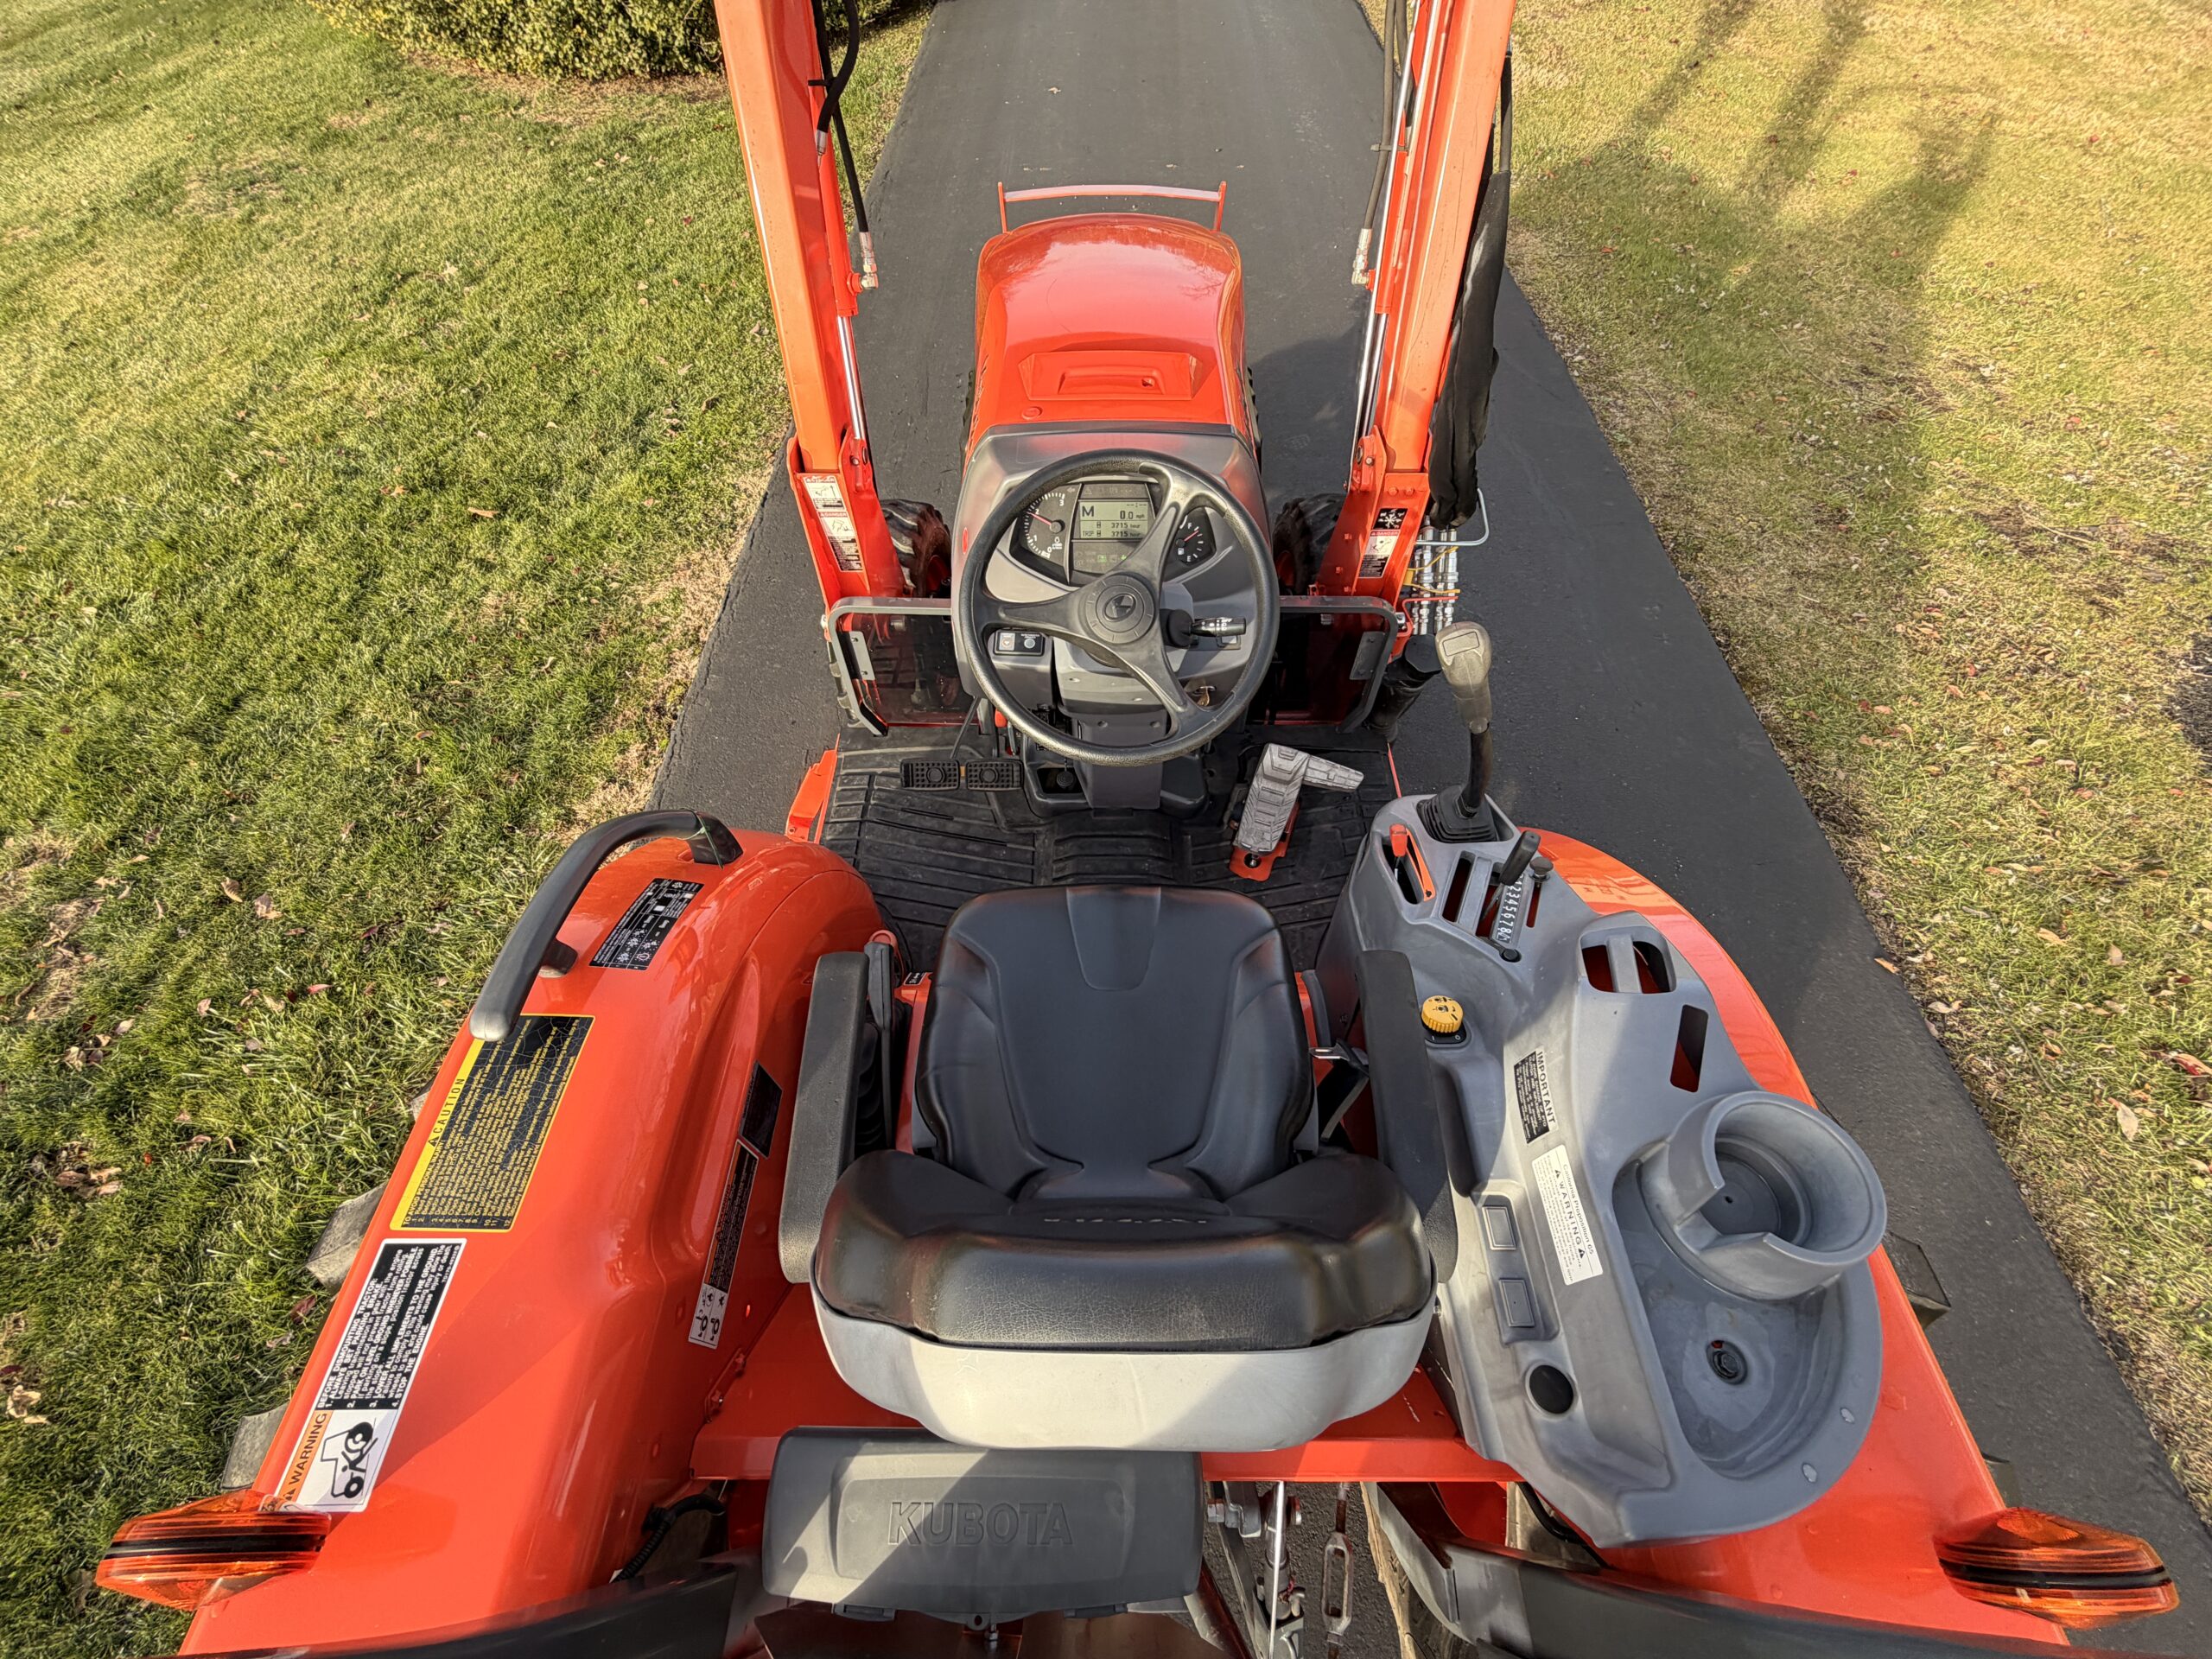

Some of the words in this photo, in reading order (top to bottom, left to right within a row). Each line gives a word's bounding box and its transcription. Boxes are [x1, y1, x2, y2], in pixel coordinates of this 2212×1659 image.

[1082, 505, 1094, 517] M
[432, 1077, 465, 1133] CAUTION
[1536, 1051, 1555, 1125] IMPORTANT
[416, 1162, 435, 1194] PERSONAL
[403, 1216, 411, 1224] TO
[406, 1196, 420, 1215] AVOID
[1558, 1180, 1581, 1245] WARNING
[409, 1294, 420, 1304] TO
[414, 1279, 426, 1293] THE
[316, 1376, 336, 1408] BEFORE
[332, 1318, 360, 1371] DISMOUNTING
[356, 1278, 378, 1314] TRACTOR:
[334, 1370, 353, 1398] Leaving
[347, 1325, 371, 1368] transmission
[371, 1300, 383, 1314] gear
[377, 1284, 388, 1298] with
[383, 1272, 393, 1282] the
[389, 1249, 404, 1270] engine
[342, 1370, 360, 1398] stopped
[355, 1356, 365, 1368] will
[360, 1343, 371, 1354] not
[366, 1316, 382, 1341] prevent
[378, 1292, 391, 1313] tractor
[387, 1274, 398, 1290] from
[350, 1378, 364, 1398] PARK
[359, 1367, 369, 1376] ON
[364, 1344, 378, 1365] LEVEL
[372, 1314, 391, 1343] GROUND
[385, 1278, 405, 1313] WHENEVER
[360, 1363, 378, 1391] parking
[372, 1352, 382, 1362] on
[389, 1294, 405, 1321] position
[400, 1271, 415, 1293] tractor
[410, 1248, 424, 1268] across
[379, 1373, 395, 1398] Failure
[394, 1338, 410, 1363] comply
[407, 1316, 417, 1328] this
[413, 1289, 429, 1314] warning
[423, 1274, 435, 1287] may
[429, 1256, 441, 1272] allow
[436, 1244, 446, 1255] the
[387, 1372, 402, 1398] wheels
[407, 1334, 417, 1346] and
[412, 1314, 425, 1332] could
[420, 1294, 433, 1313] cause
[429, 1273, 442, 1290] injury
[390, 1306, 415, 1352] IMPLEMENTS
[327, 1367, 347, 1398] ALWAYS
[343, 1348, 354, 1363] SET
[351, 1312, 371, 1344] PARKING
[384, 1354, 396, 1368] ALL
[394, 1376, 409, 1398] STOP
[404, 1357, 416, 1372] THE
[365, 1386, 374, 1398] the
[372, 1370, 390, 1398] LOWER
[288, 1413, 327, 1484] WARNING
[887, 1500, 1075, 1547] KUBOTA
